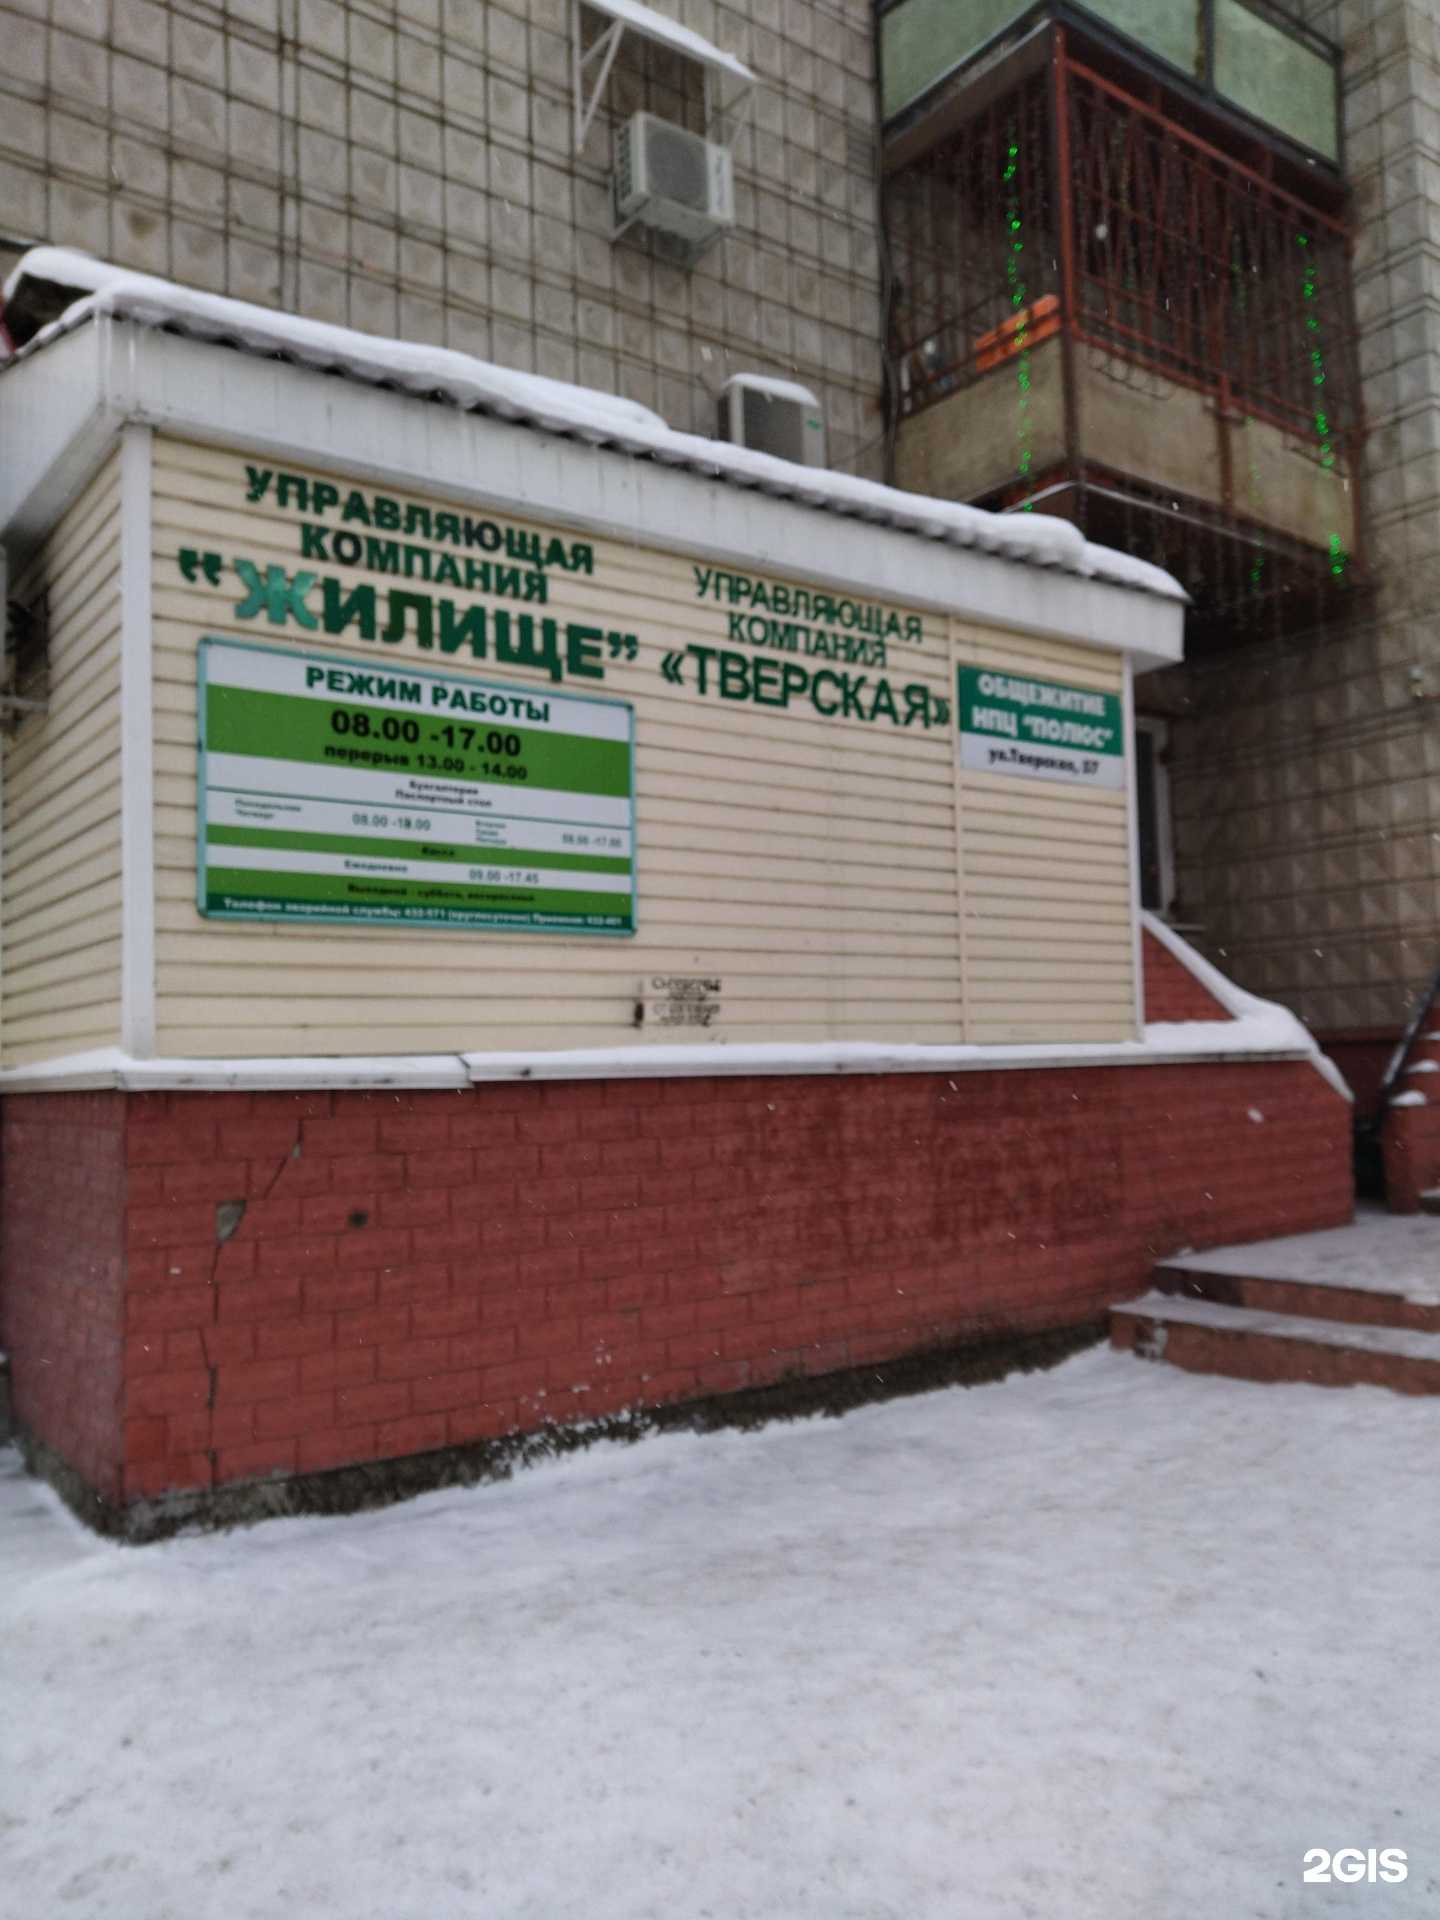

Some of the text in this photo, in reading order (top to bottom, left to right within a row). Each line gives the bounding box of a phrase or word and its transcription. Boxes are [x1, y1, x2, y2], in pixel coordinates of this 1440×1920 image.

[245, 466, 594, 575] УПРАВЛЯЮЩАЯ
[300, 522, 549, 604] КОМПАНИЯ
[693, 566, 923, 644] УПРАВЛЯЮЩАЯ
[728, 611, 888, 670] КОМПАНИЯ
[306, 665, 550, 722] РЕЖИМ РАБОТЫ
[971, 705, 1018, 738] НПЦ
[977, 673, 1106, 718] ОБЩЕЖИТИЕ
[330, 709, 420, 743] 08.00
[324, 743, 410, 769] перерыв
[416, 752, 465, 773] 13.00
[481, 761, 528, 781] 14.00
